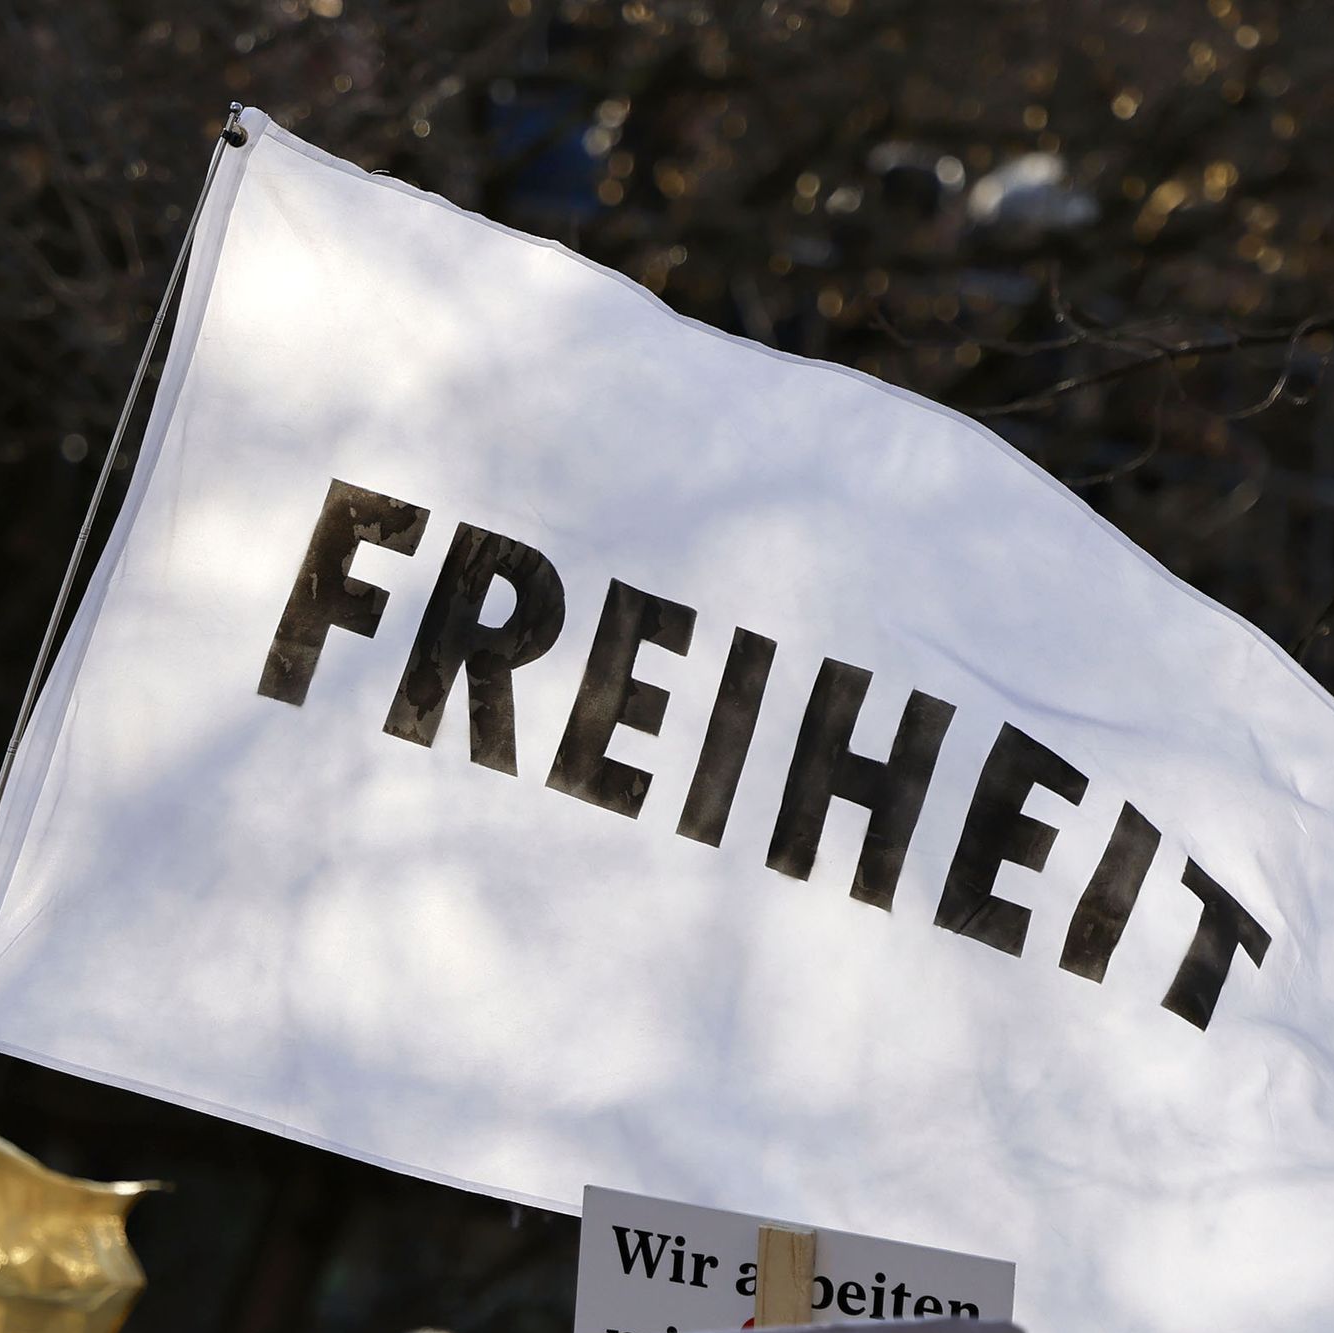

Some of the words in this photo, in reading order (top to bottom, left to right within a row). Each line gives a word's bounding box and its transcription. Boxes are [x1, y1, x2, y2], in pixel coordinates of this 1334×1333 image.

[257, 478, 1272, 1032] FREIHEIT
[612, 1225, 719, 1288] Wir
[735, 1260, 980, 1321] abeiten
